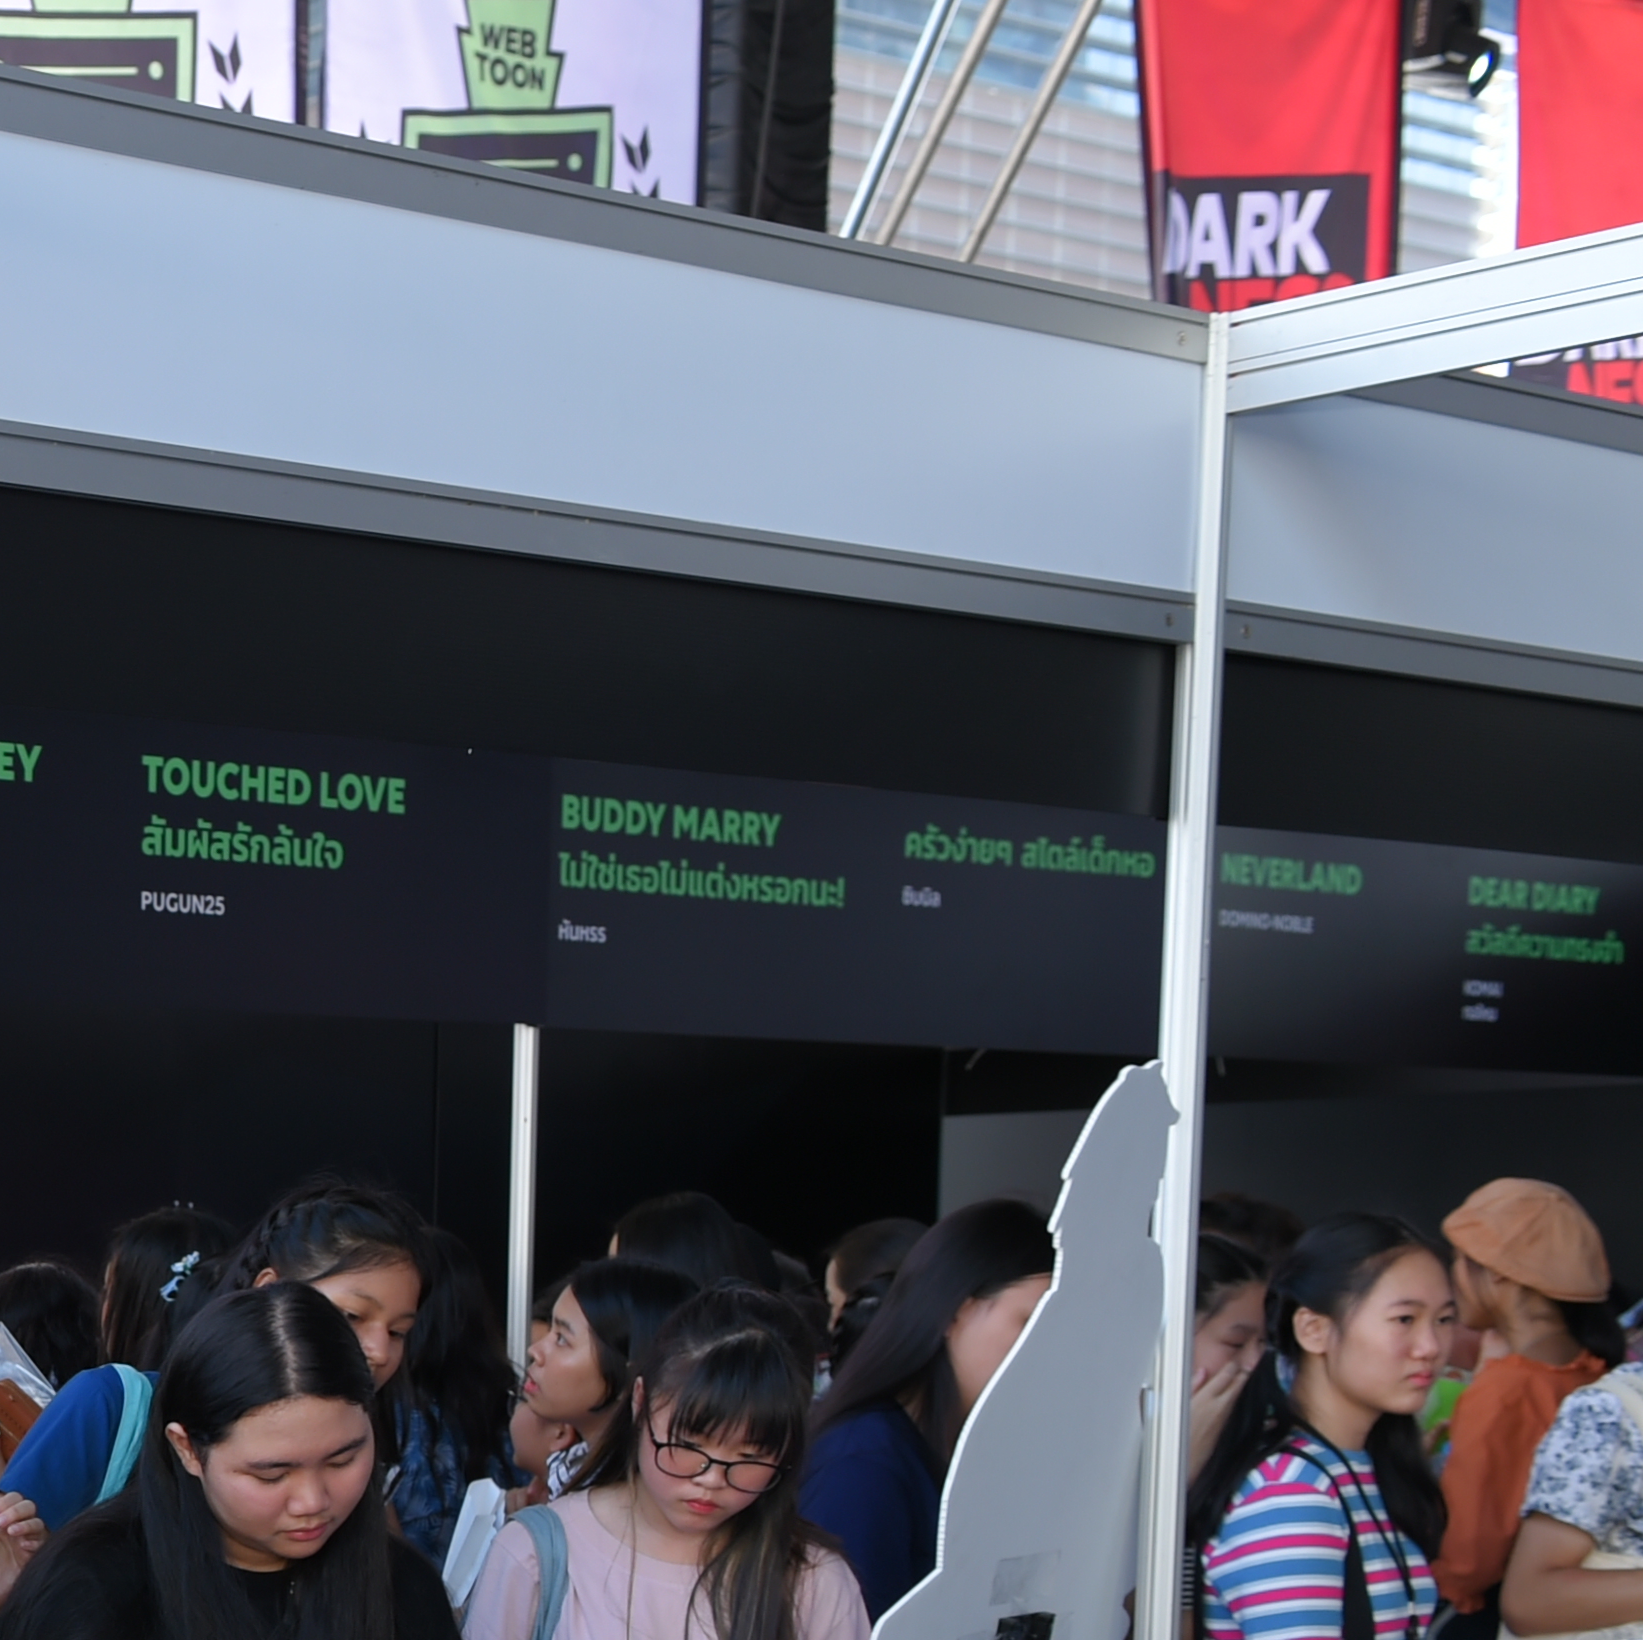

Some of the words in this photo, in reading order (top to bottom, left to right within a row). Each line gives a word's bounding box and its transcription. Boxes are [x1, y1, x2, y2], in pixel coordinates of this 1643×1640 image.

[478, 22, 538, 60] WEB
[473, 49, 547, 92] TOON
[143, 755, 313, 805] TOUCHED
[320, 773, 406, 814] LOVE
[562, 795, 665, 835] BUDDY
[673, 806, 781, 844] MARRY
[141, 814, 345, 870] สัมผัสรักล้นใจ
[1222, 854, 1363, 896] NEVERLAND
[1471, 877, 1529, 907] DEAR
[1533, 883, 1599, 912] DIARY
[140, 890, 226, 916] PUGUN25
